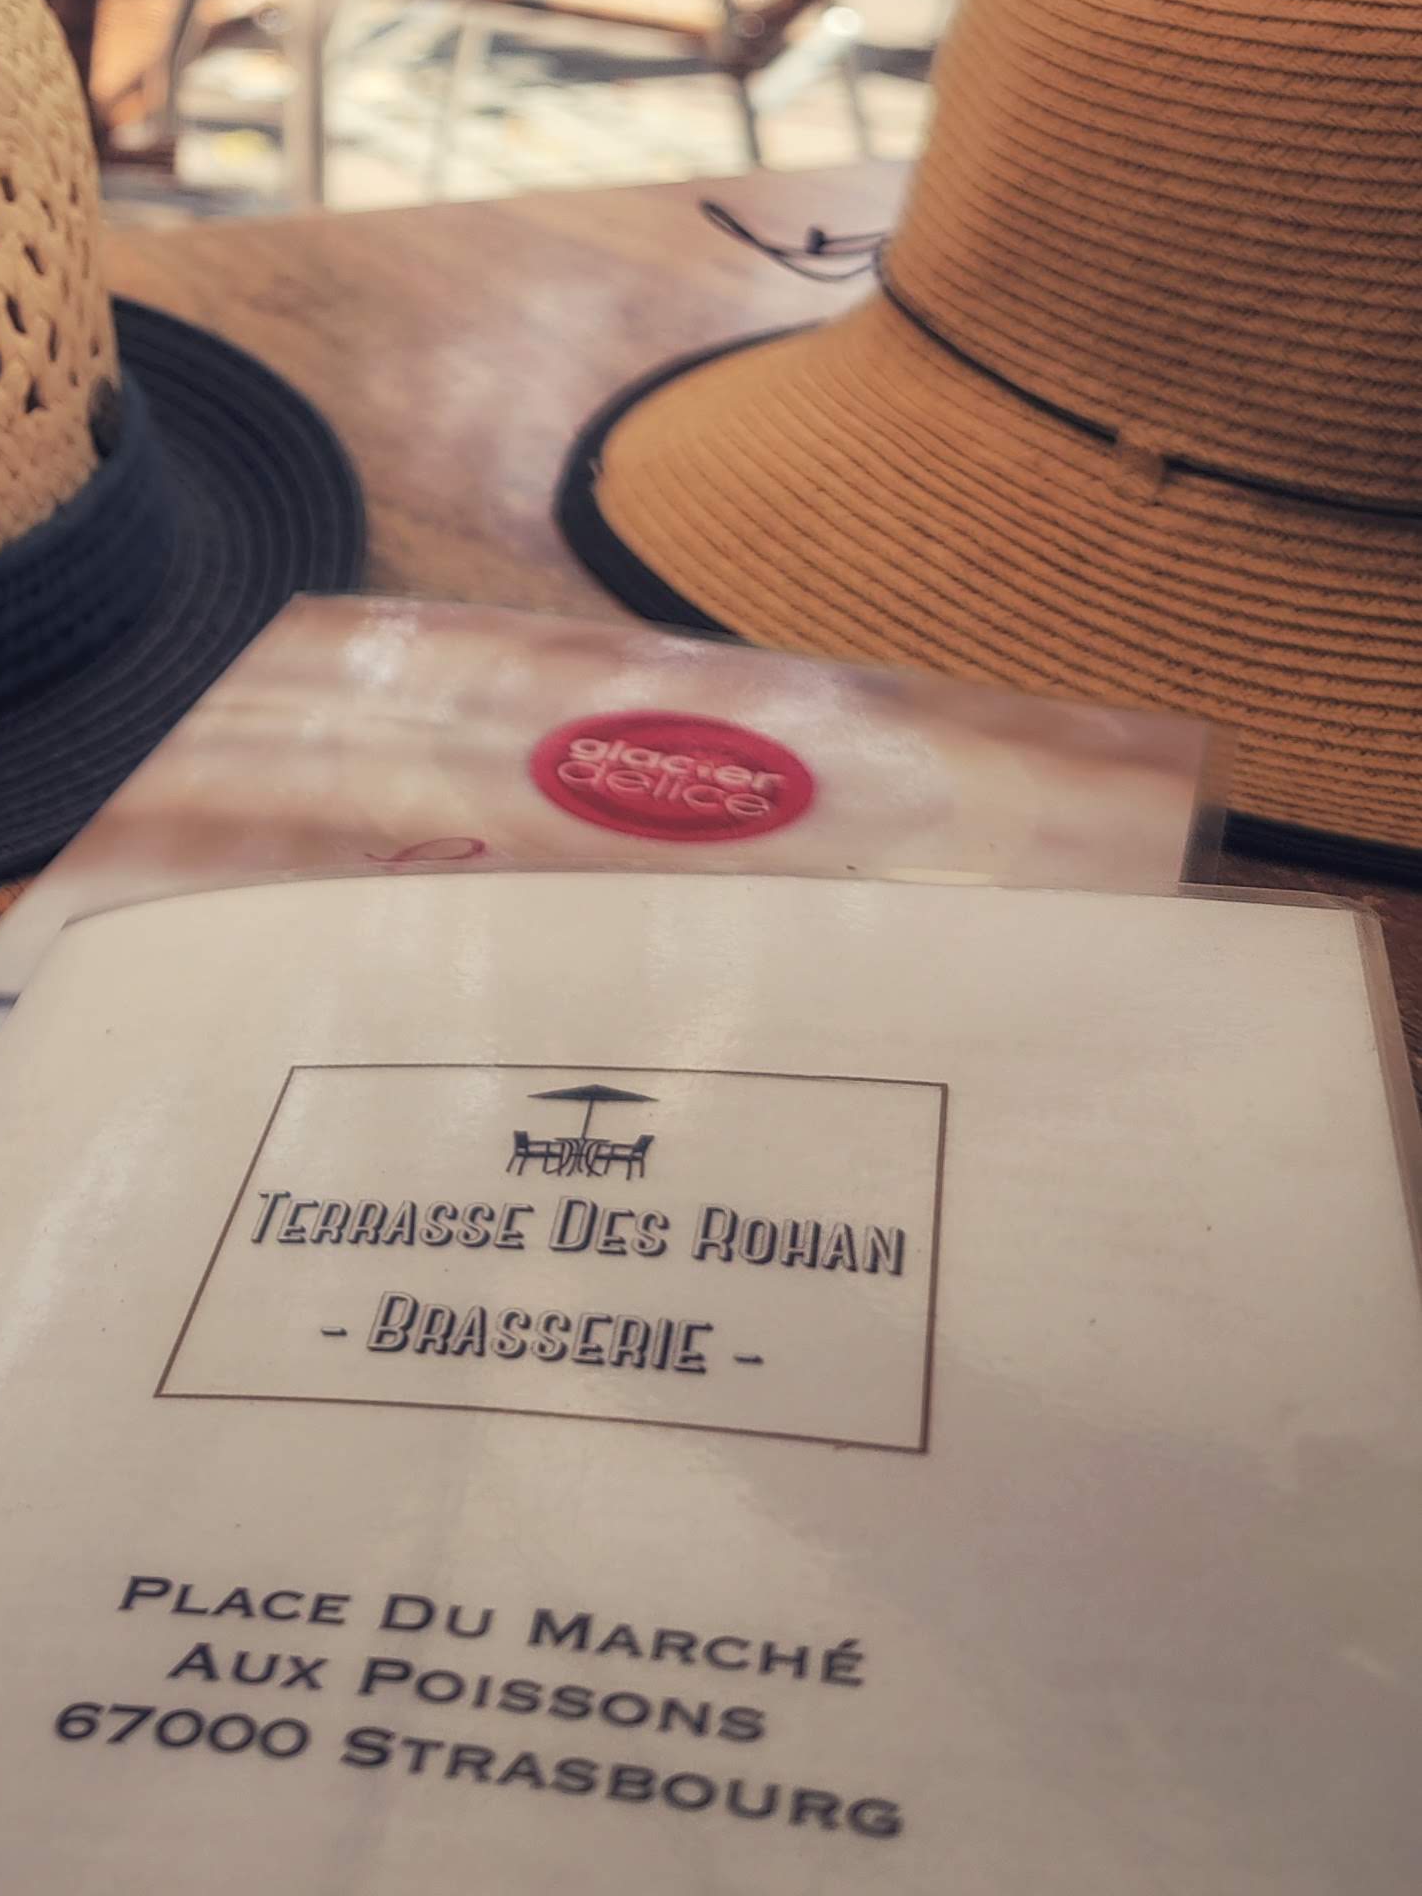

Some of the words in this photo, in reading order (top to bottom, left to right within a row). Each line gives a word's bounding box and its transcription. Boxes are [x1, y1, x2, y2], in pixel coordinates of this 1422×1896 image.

[249, 1190, 535, 1251] TERRASSE
[548, 1196, 671, 1258] DES
[690, 1205, 907, 1278] ROHAN
[366, 1291, 716, 1376] BRASSERIE
[116, 1574, 352, 1627] PLACE
[378, 1592, 496, 1641] DU
[526, 1607, 866, 1689] MARCHÉ
[166, 1641, 329, 1692] AUX
[357, 1656, 766, 1744] POISSONS
[52, 1700, 312, 1762] 67000
[339, 1725, 905, 1841] STRASBOURG
